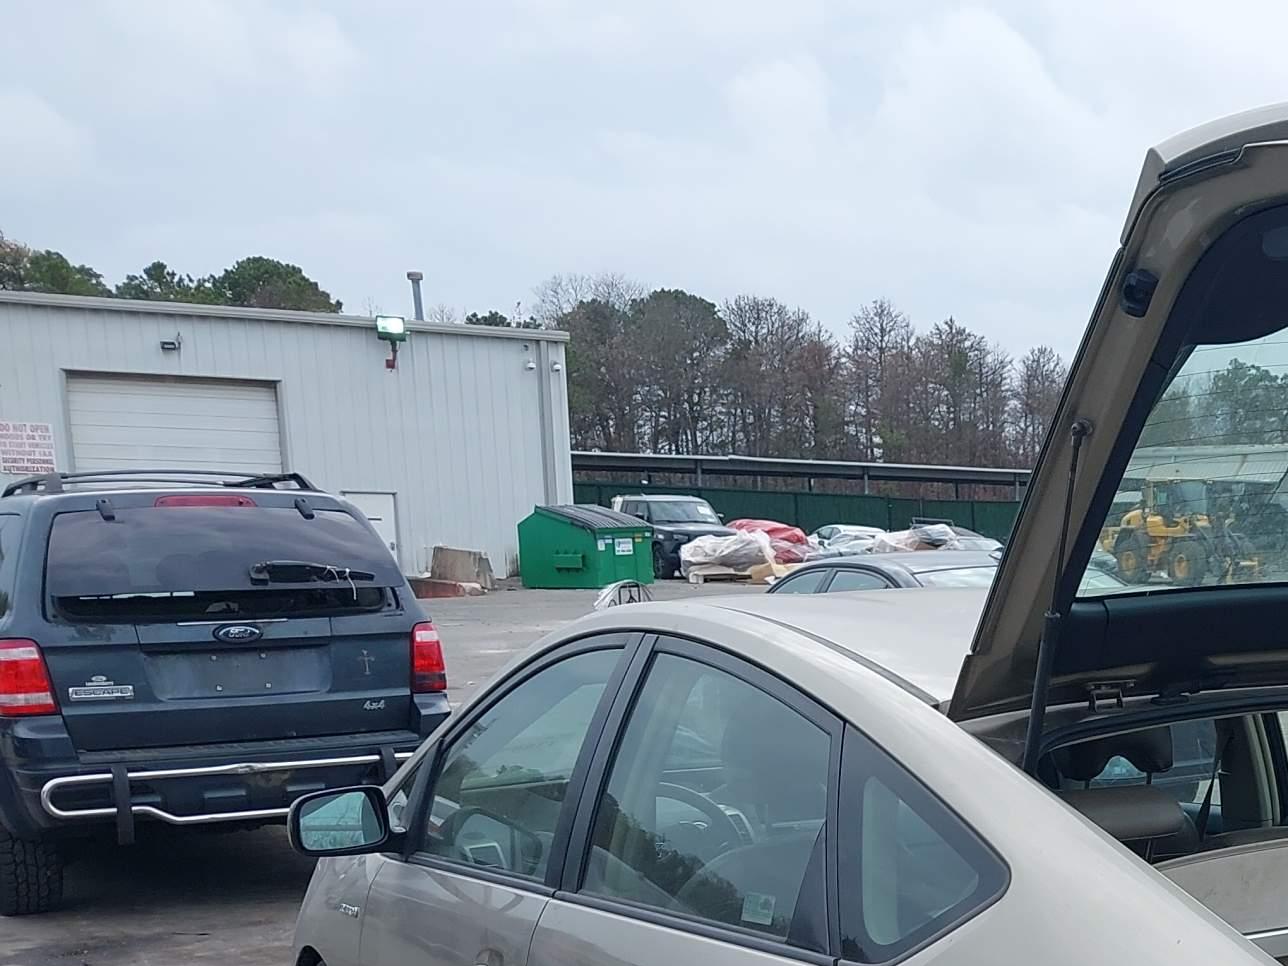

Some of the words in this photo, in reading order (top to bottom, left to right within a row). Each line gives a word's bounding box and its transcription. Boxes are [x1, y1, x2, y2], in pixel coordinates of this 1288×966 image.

[12, 423, 27, 433] NOT
[30, 423, 49, 433] OPEN
[72, 685, 131, 697] ESCAPE
